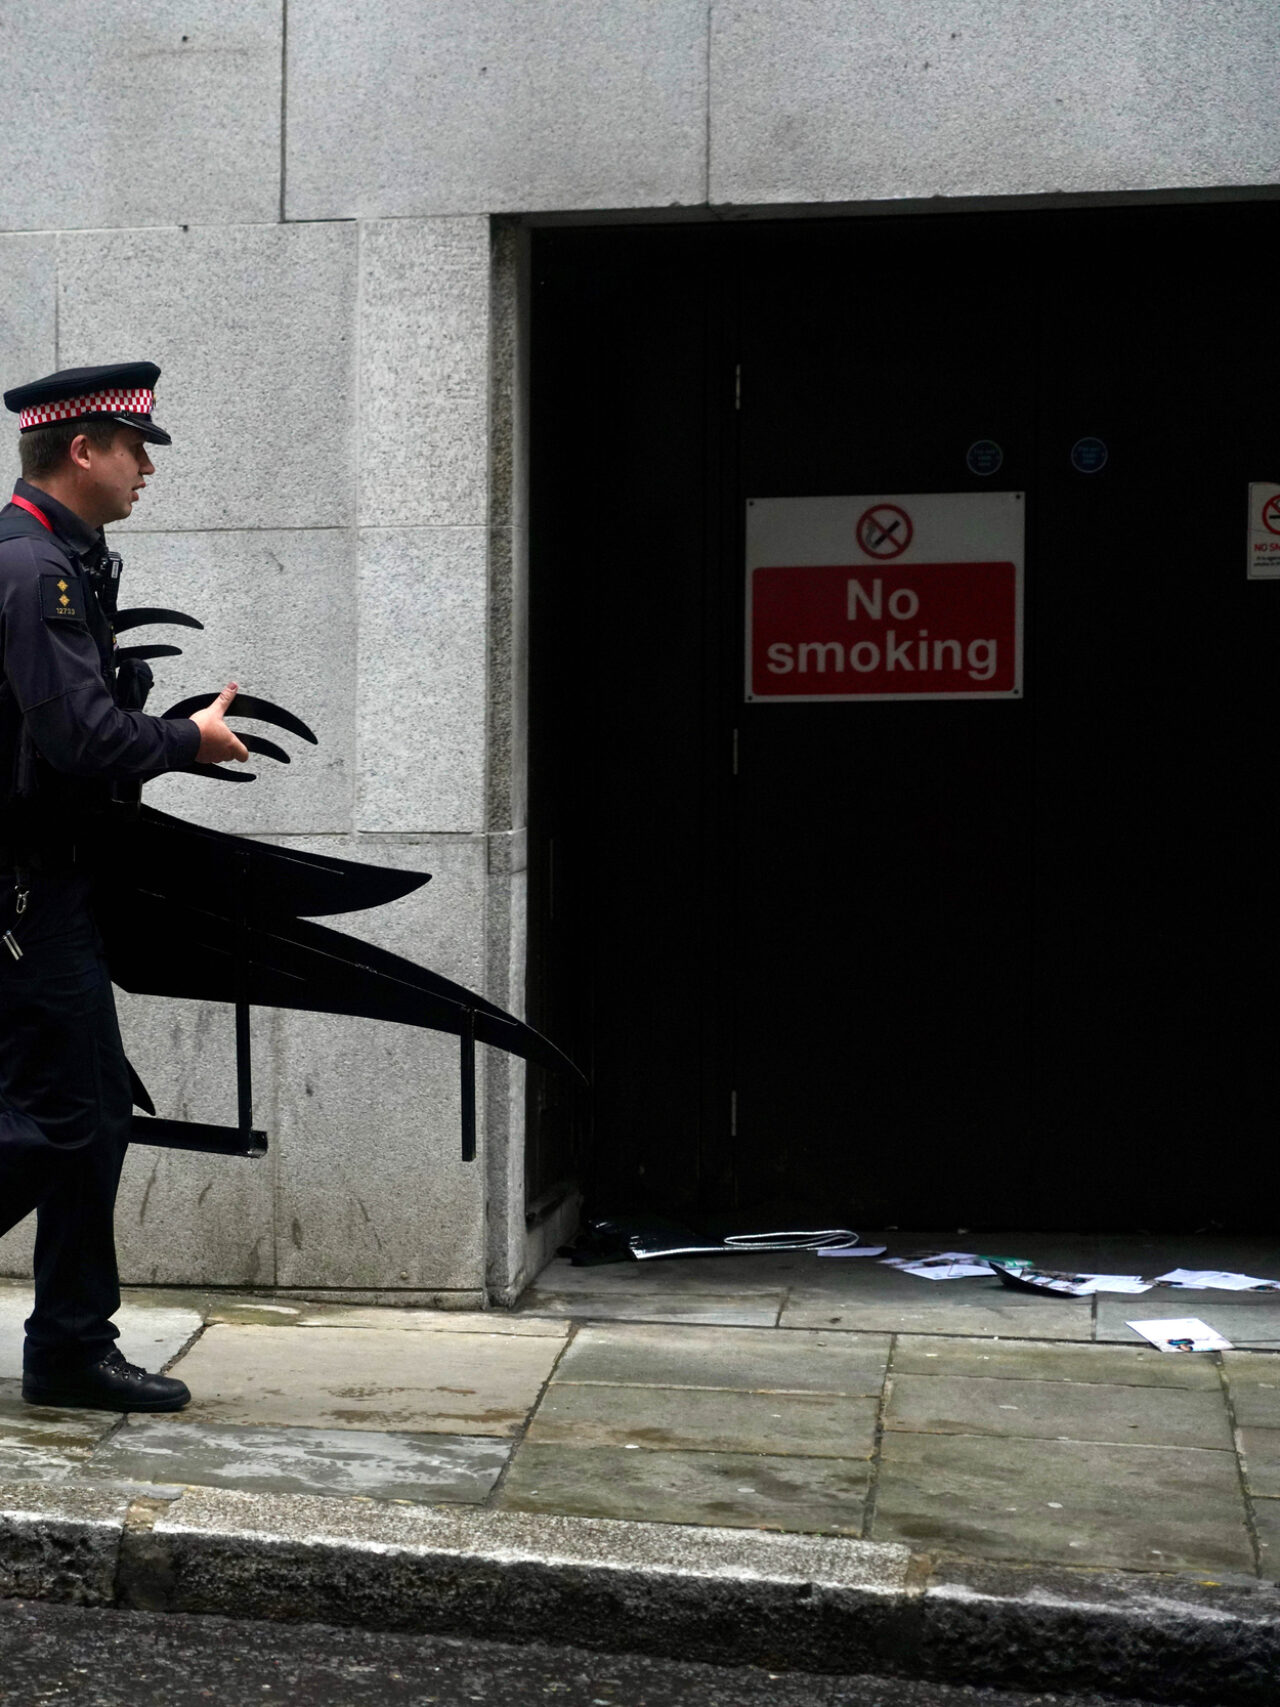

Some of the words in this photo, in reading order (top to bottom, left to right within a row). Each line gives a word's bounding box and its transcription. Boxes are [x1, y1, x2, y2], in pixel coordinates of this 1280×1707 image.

[1254, 543, 1268, 552] NO
[847, 578, 919, 620] No
[767, 629, 997, 681] smoking
